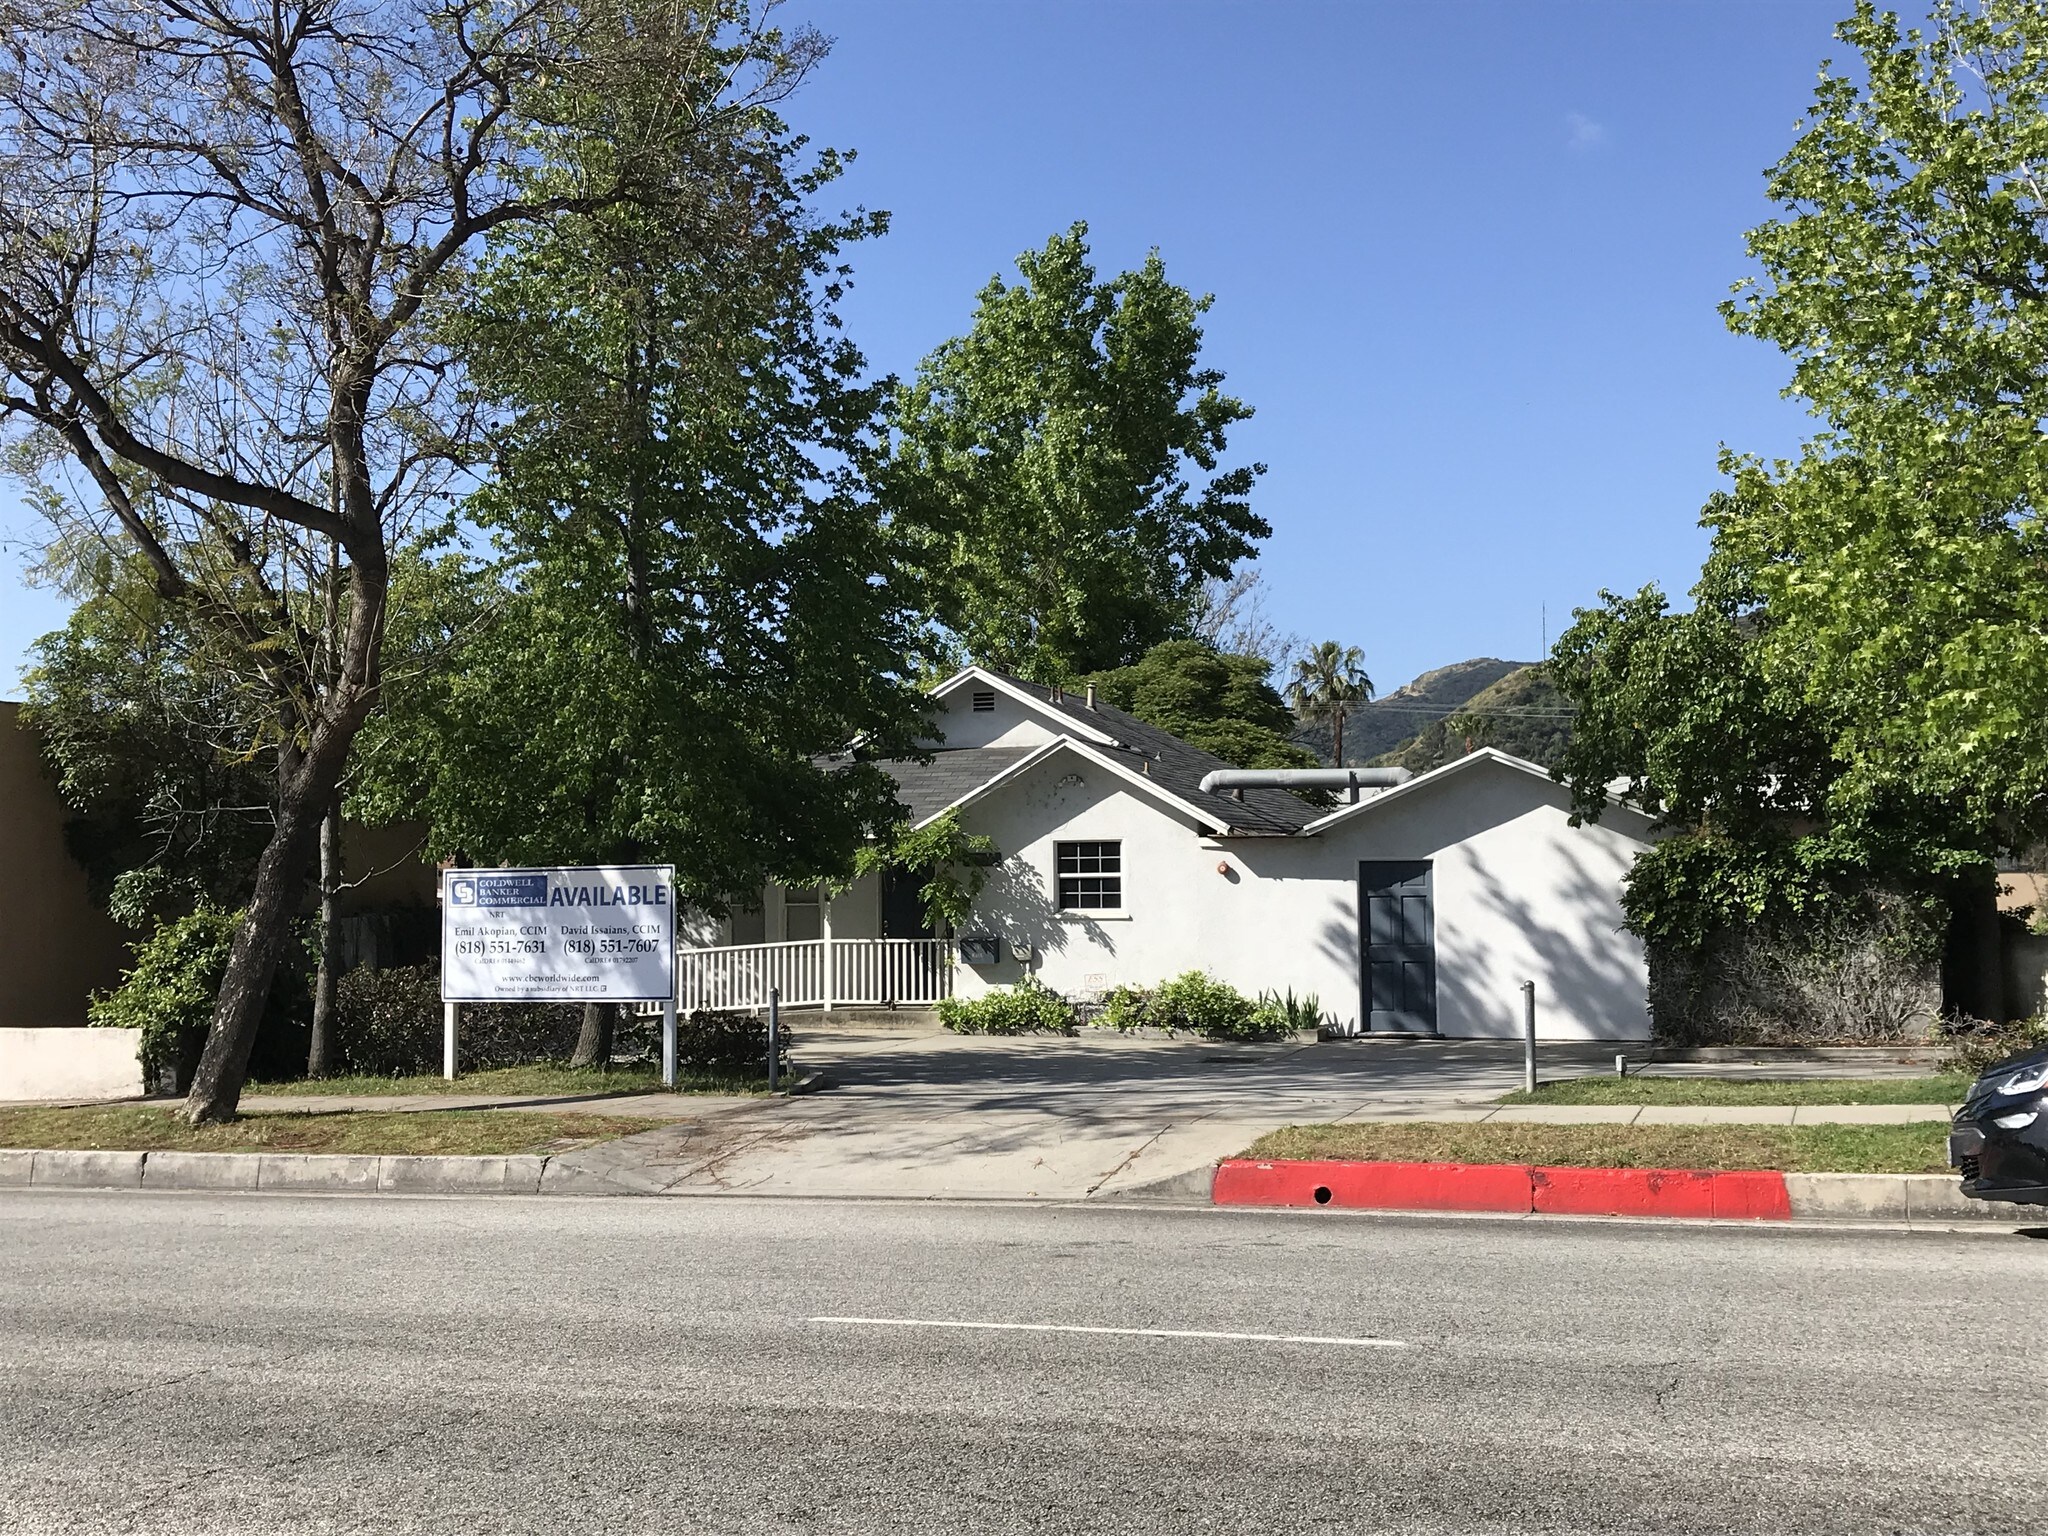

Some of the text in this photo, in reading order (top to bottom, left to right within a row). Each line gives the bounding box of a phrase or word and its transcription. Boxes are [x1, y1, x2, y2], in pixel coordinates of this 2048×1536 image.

[479, 879, 534, 888] COLDWELL
[479, 888, 520, 896] BANKER
[550, 885, 666, 907] AVAILABLE
[479, 897, 546, 905] COMMERCIAL
[455, 926, 547, 938] Emil Akopian, CCIM
[561, 925, 661, 936] David Issaians, CCIM
[455, 940, 547, 957] (818) 551-7631
[564, 939, 660, 956] (818) 551-7607
[502, 974, 600, 983] www.cbcworldwide.com
[530, 985, 561, 993] subsidiary
